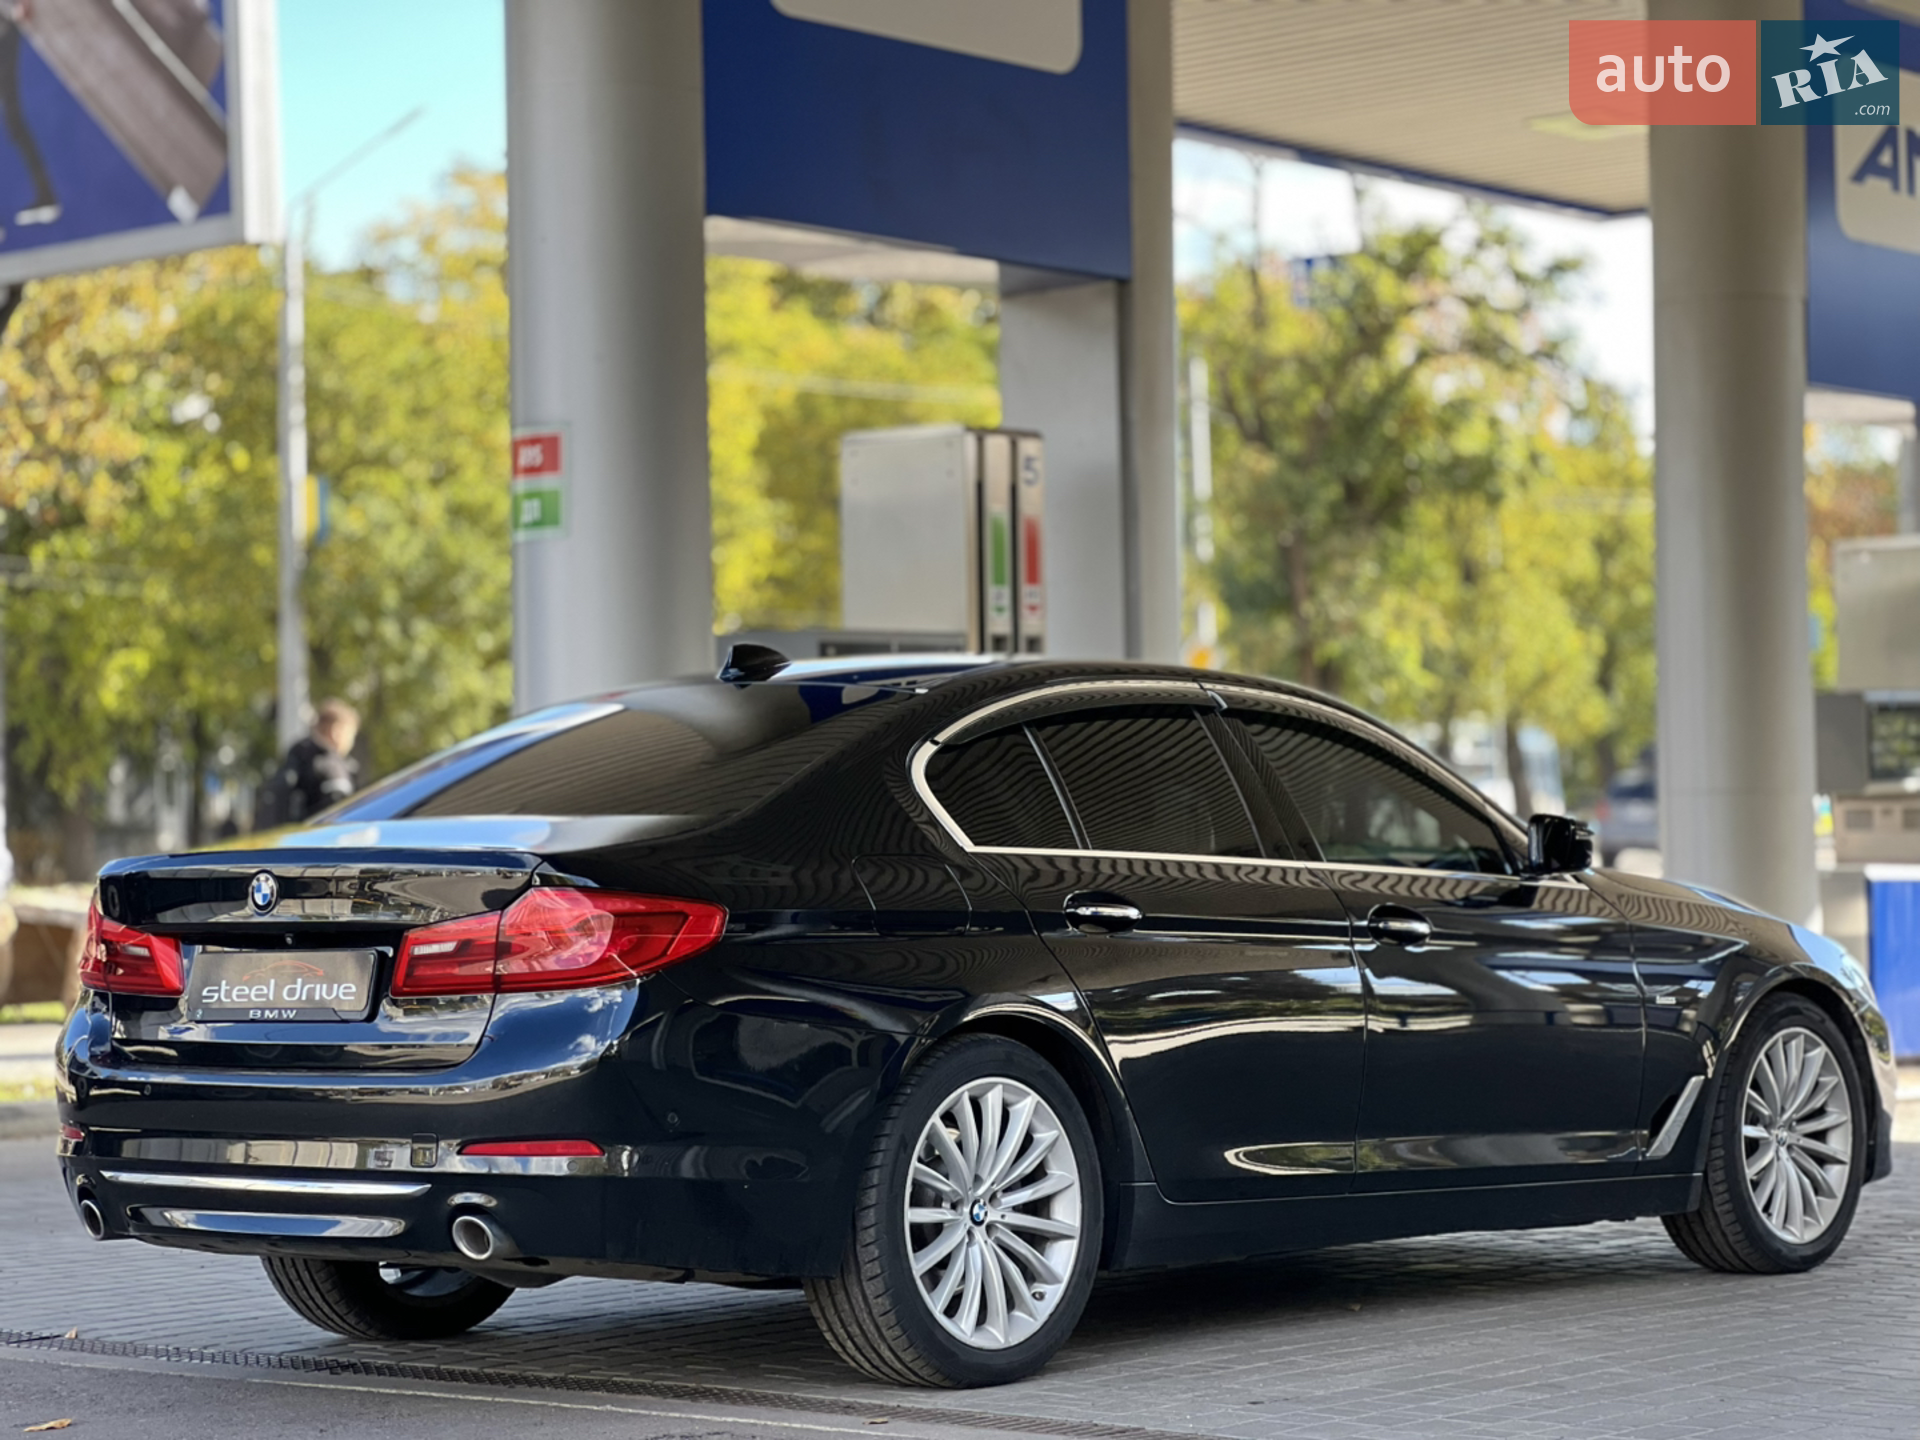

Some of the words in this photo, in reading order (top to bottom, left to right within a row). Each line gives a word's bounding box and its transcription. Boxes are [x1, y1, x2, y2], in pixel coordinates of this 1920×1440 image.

[1023, 455, 1041, 488] 5
[201, 979, 276, 1003] steel
[282, 978, 357, 1001] drive
[249, 1008, 297, 1019] BMW
